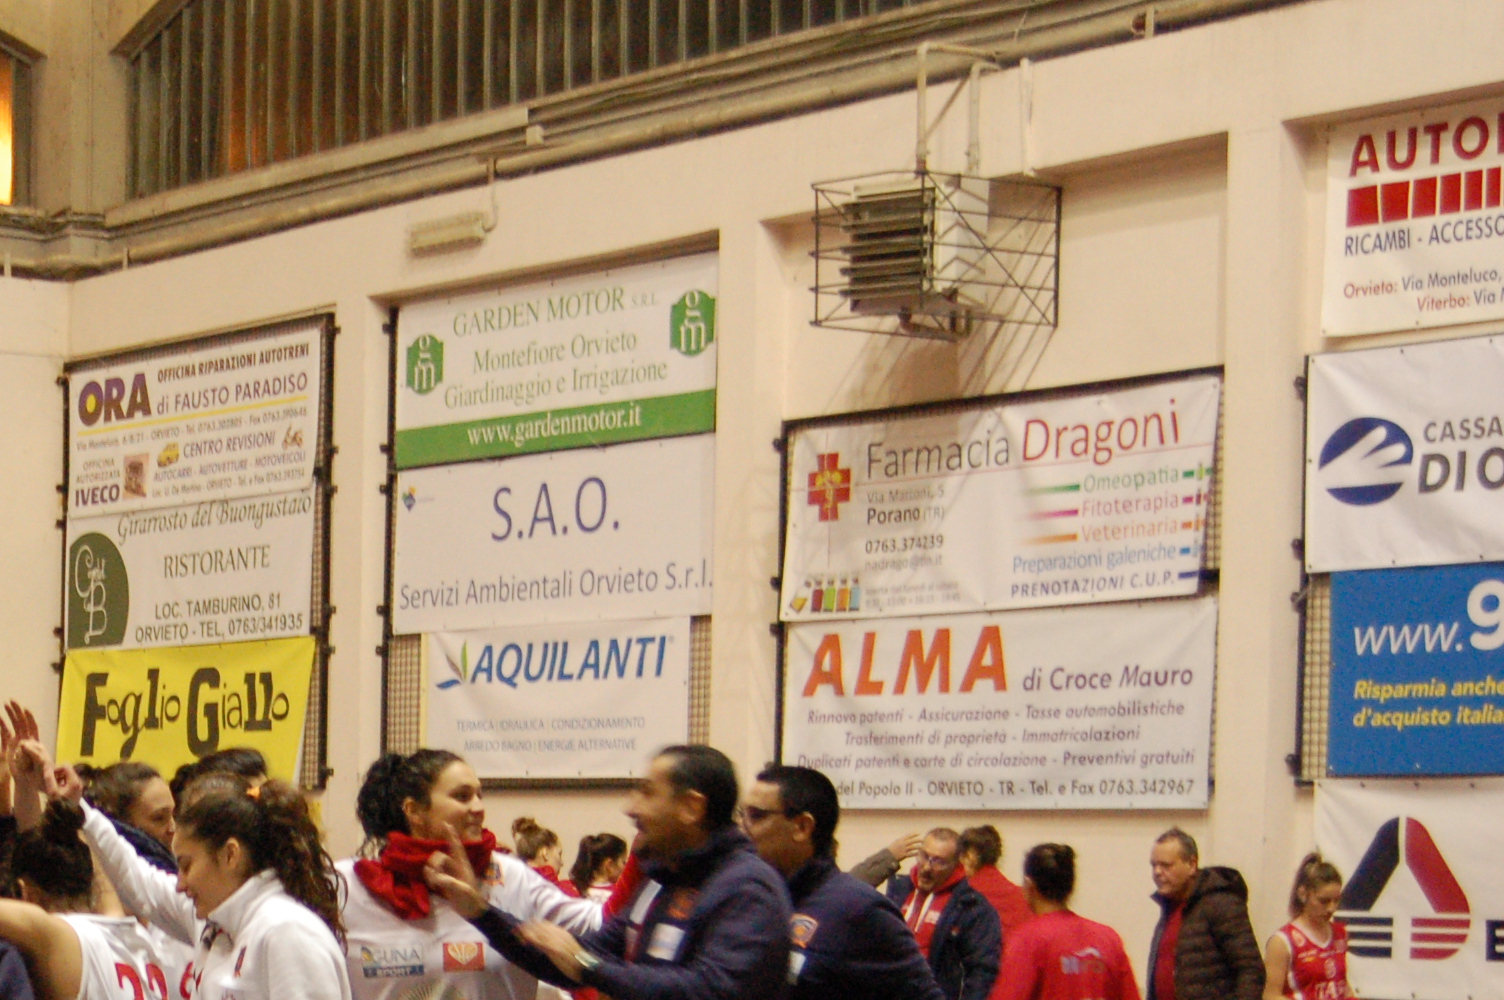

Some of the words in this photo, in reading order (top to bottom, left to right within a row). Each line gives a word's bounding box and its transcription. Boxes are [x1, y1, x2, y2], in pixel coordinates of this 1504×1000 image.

[1348, 114, 1504, 178] AUTO
[1344, 228, 1411, 257] RICAMBI
[1344, 280, 1398, 299] Orvieto:
[1401, 275, 1424, 291] Via
[1416, 293, 1470, 312] Viterbo:
[1473, 288, 1496, 305] Via
[453, 302, 540, 338] GARDEN
[547, 287, 625, 322] MOTOR
[157, 364, 196, 384] OFFICINA
[198, 353, 257, 376] RIPARAZIONI
[258, 343, 310, 364] AUTOTRENI
[473, 340, 566, 375] Montefiore
[571, 330, 637, 359] Orvieto
[157, 396, 169, 415] di
[174, 387, 230, 413] FAUSTO
[235, 372, 308, 400] PARADISO
[444, 374, 551, 410] Giardinaggio
[556, 377, 566, 394] e
[572, 361, 668, 396] Irrigazione
[78, 372, 152, 427] ORA
[467, 402, 642, 447] www.gardenmotor.it
[1423, 416, 1503, 443] CASSA
[183, 439, 223, 458] CENTRO
[226, 430, 276, 452] REVISIONI
[866, 431, 1011, 481] Farmacia
[1022, 398, 1181, 465] Dragoni
[199, 459, 247, 475] AUTOVETTURE
[1083, 466, 1179, 493] Omeopatia
[75, 484, 120, 507] IVECO
[491, 476, 620, 542] S.A.O.
[867, 490, 884, 504] Via
[1082, 493, 1179, 517] Fitoterapia
[118, 507, 189, 547] Girarrosto
[191, 502, 211, 528] del
[867, 506, 920, 525] Porano
[1081, 518, 1178, 543] Veterinaria
[164, 545, 270, 579] RISTORANTE
[1013, 552, 1102, 575] Preparazioni
[1107, 544, 1177, 570] galeniche
[399, 579, 460, 611] Servizi
[465, 570, 573, 605] Ambientali
[579, 567, 658, 597] Orvieto
[665, 558, 713, 591] S.r.l.
[1011, 575, 1124, 598] PRENOTAZIONI
[1130, 571, 1174, 588] C.U.P.
[155, 603, 183, 620] LOC.
[135, 622, 189, 642] ORVIETO
[228, 613, 303, 635] 0763/341935
[470, 635, 667, 689] AQUILANTI
[801, 625, 1008, 698] ALMA
[1023, 668, 1041, 692] di
[1050, 667, 1112, 692] Croce
[1119, 664, 1194, 689] Mauro
[1354, 678, 1447, 703] Risparmia
[80, 667, 181, 760] Foglio
[186, 667, 289, 759] Giallo
[551, 716, 646, 731] CONDIZIONAMENTO
[807, 709, 856, 725] Rinnovo
[859, 708, 904, 725] patenti
[917, 705, 1010, 722] Assicurazione
[1026, 704, 1061, 720] Tasse
[1065, 700, 1185, 719] automobilistiche
[1353, 706, 1452, 732] d'acquisto
[578, 738, 637, 750] ALTERNATIVE
[845, 729, 924, 746] Trasferimenti
[927, 729, 941, 745] di
[943, 729, 1007, 748] proprietà
[1022, 725, 1141, 743] Immatricolazioni
[855, 754, 900, 771] patenti
[903, 757, 910, 768] e
[913, 755, 946, 768] carte
[950, 753, 963, 768] di
[966, 752, 1047, 768] circolazione
[1063, 749, 1136, 766] Preventivi
[1139, 749, 1196, 768] gratuiti
[837, 781, 854, 796] del
[858, 781, 901, 798] Popolo
[927, 780, 984, 796] ORVIETO
[999, 781, 1015, 795] TR
[1029, 780, 1053, 795] Tel.
[1058, 784, 1066, 795] e
[1071, 780, 1095, 795] Fax
[1099, 778, 1195, 796] 0763.342967
